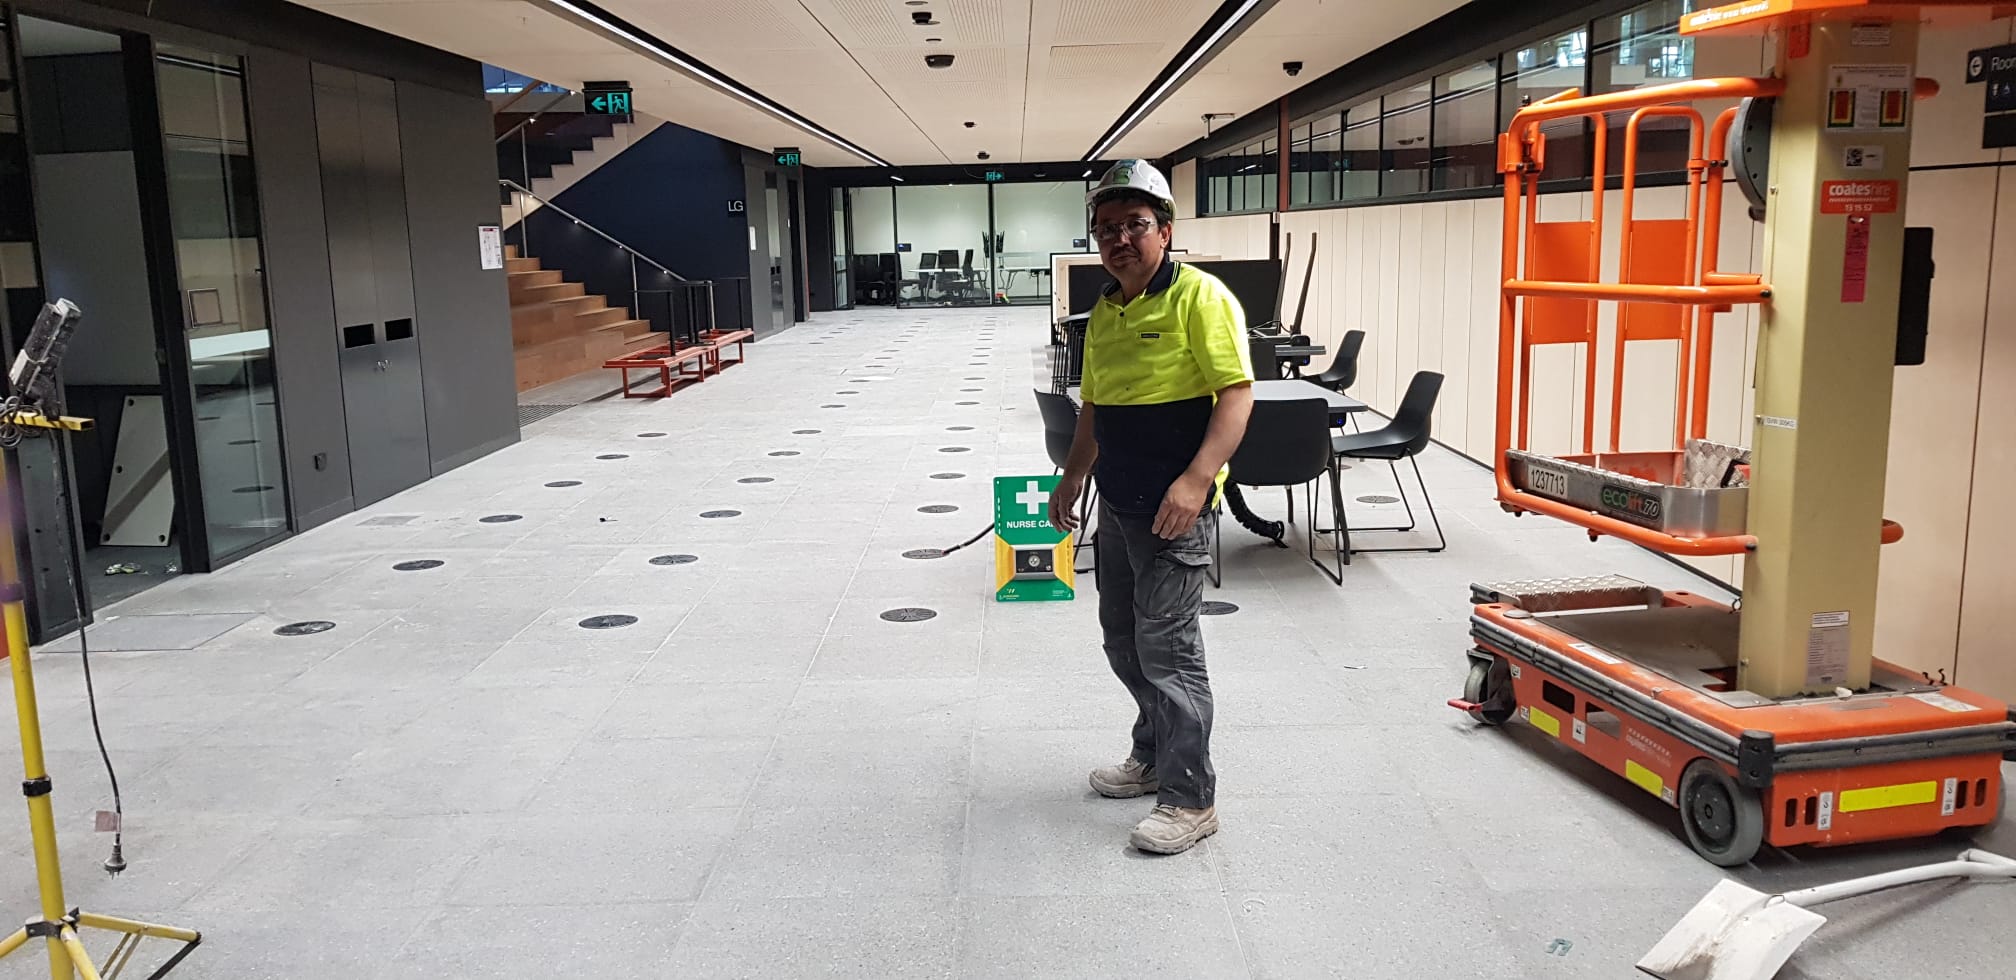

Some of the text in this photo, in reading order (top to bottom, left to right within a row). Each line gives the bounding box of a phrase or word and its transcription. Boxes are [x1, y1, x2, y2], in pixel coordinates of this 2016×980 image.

[1991, 56, 2016, 71] Roo
[728, 200, 744, 212] LG
[1530, 468, 1566, 496] 1237713
[1006, 520, 1055, 529] NURSE CA
